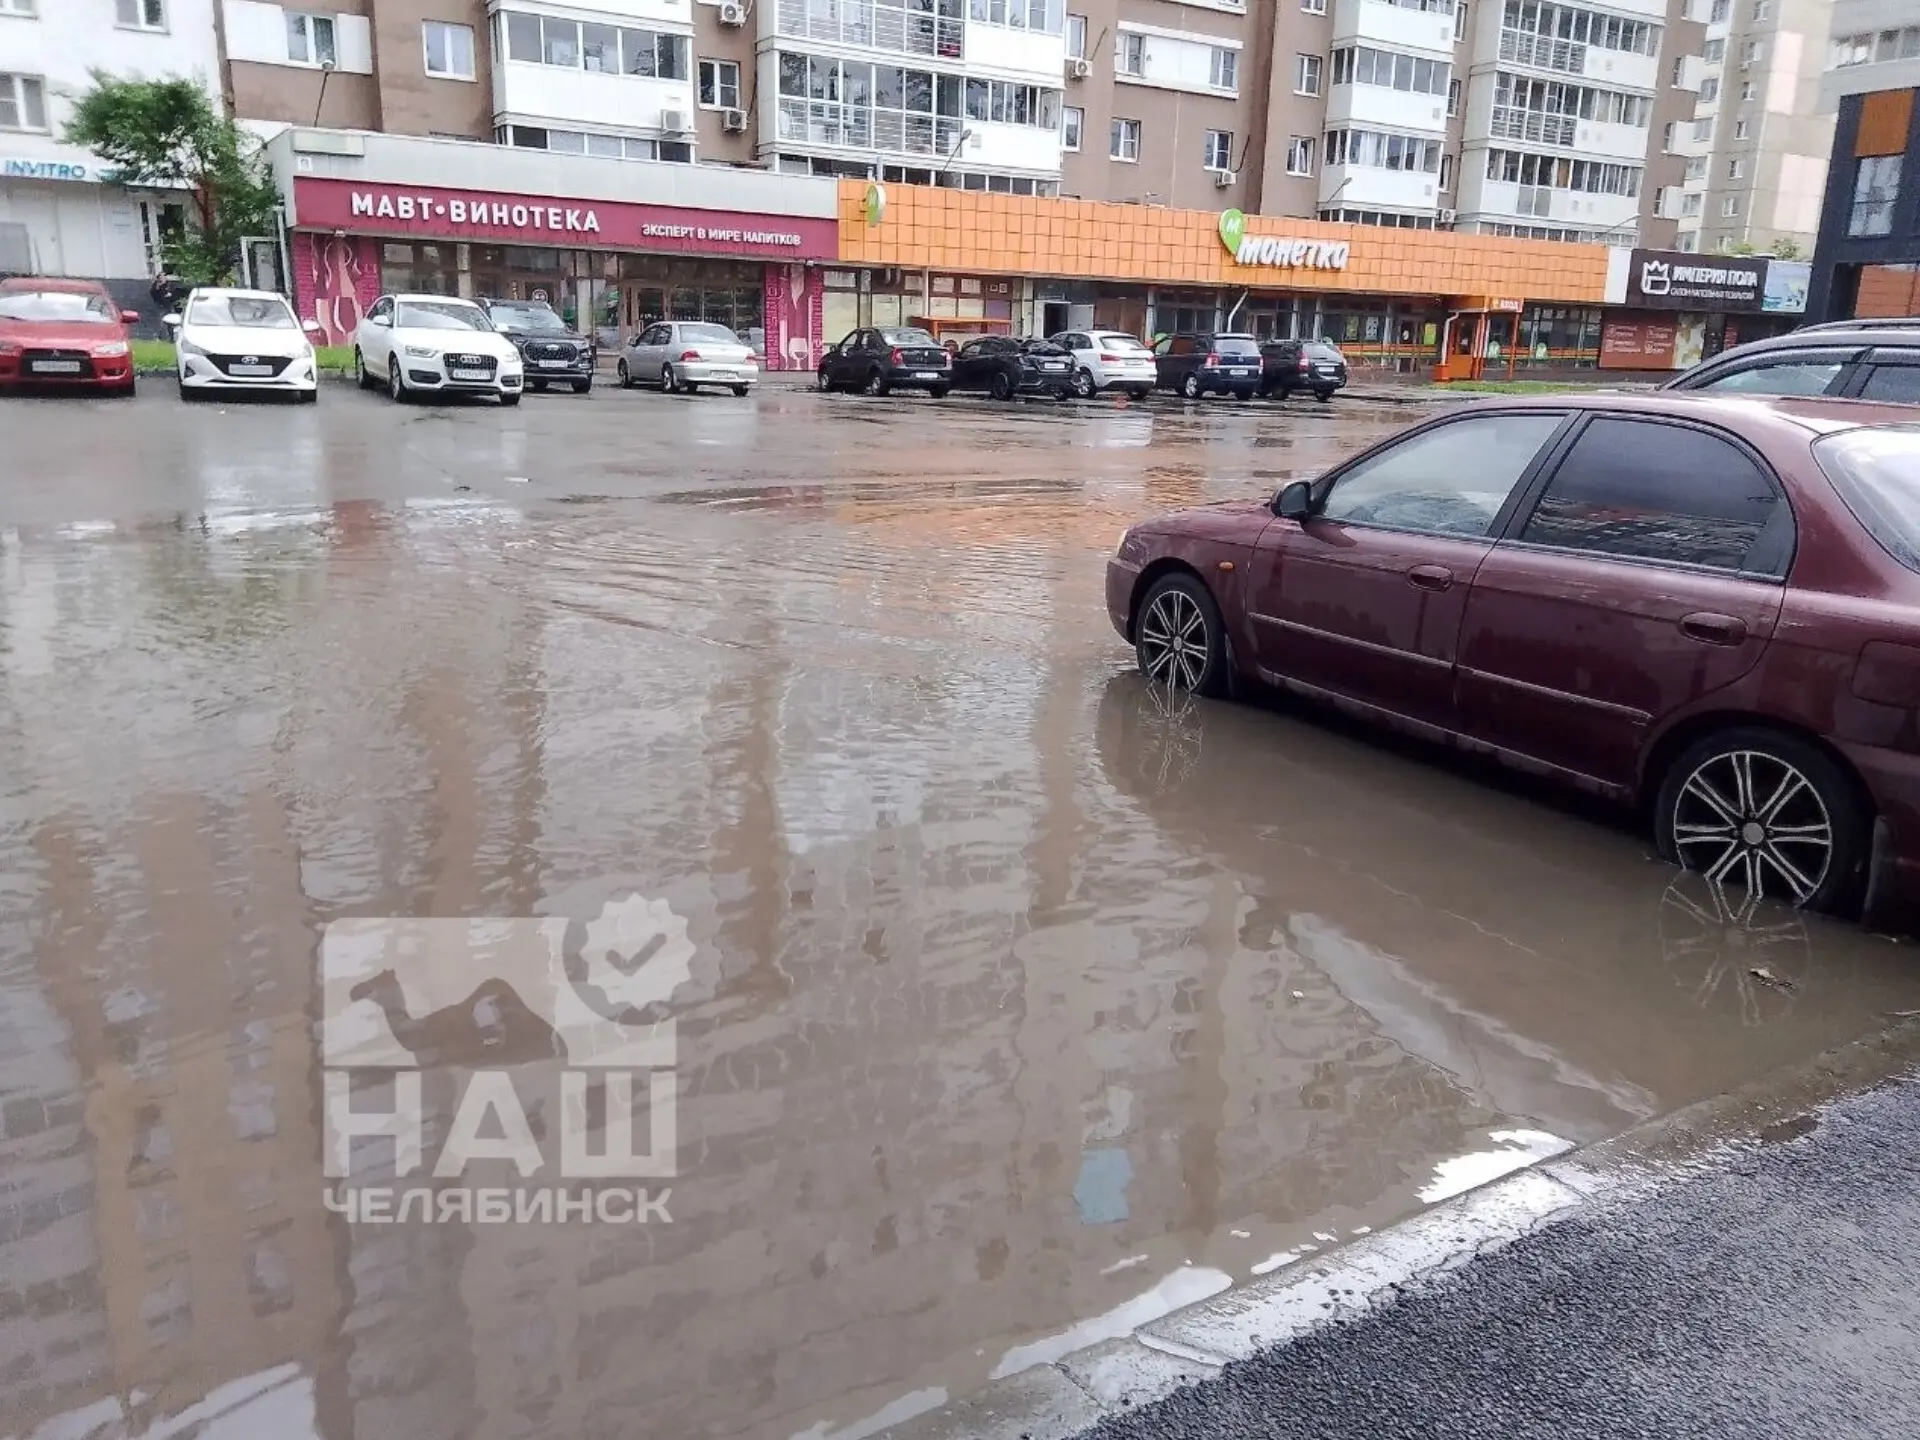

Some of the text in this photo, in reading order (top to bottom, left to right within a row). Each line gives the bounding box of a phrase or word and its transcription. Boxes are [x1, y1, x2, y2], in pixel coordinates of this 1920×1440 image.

[5, 159, 86, 178] INVITRO
[641, 223, 802, 246] ЭКСПЕРТ В МИРЕ НАПИТКОВ
[1672, 266, 1727, 284] ИМПЕРИЯ
